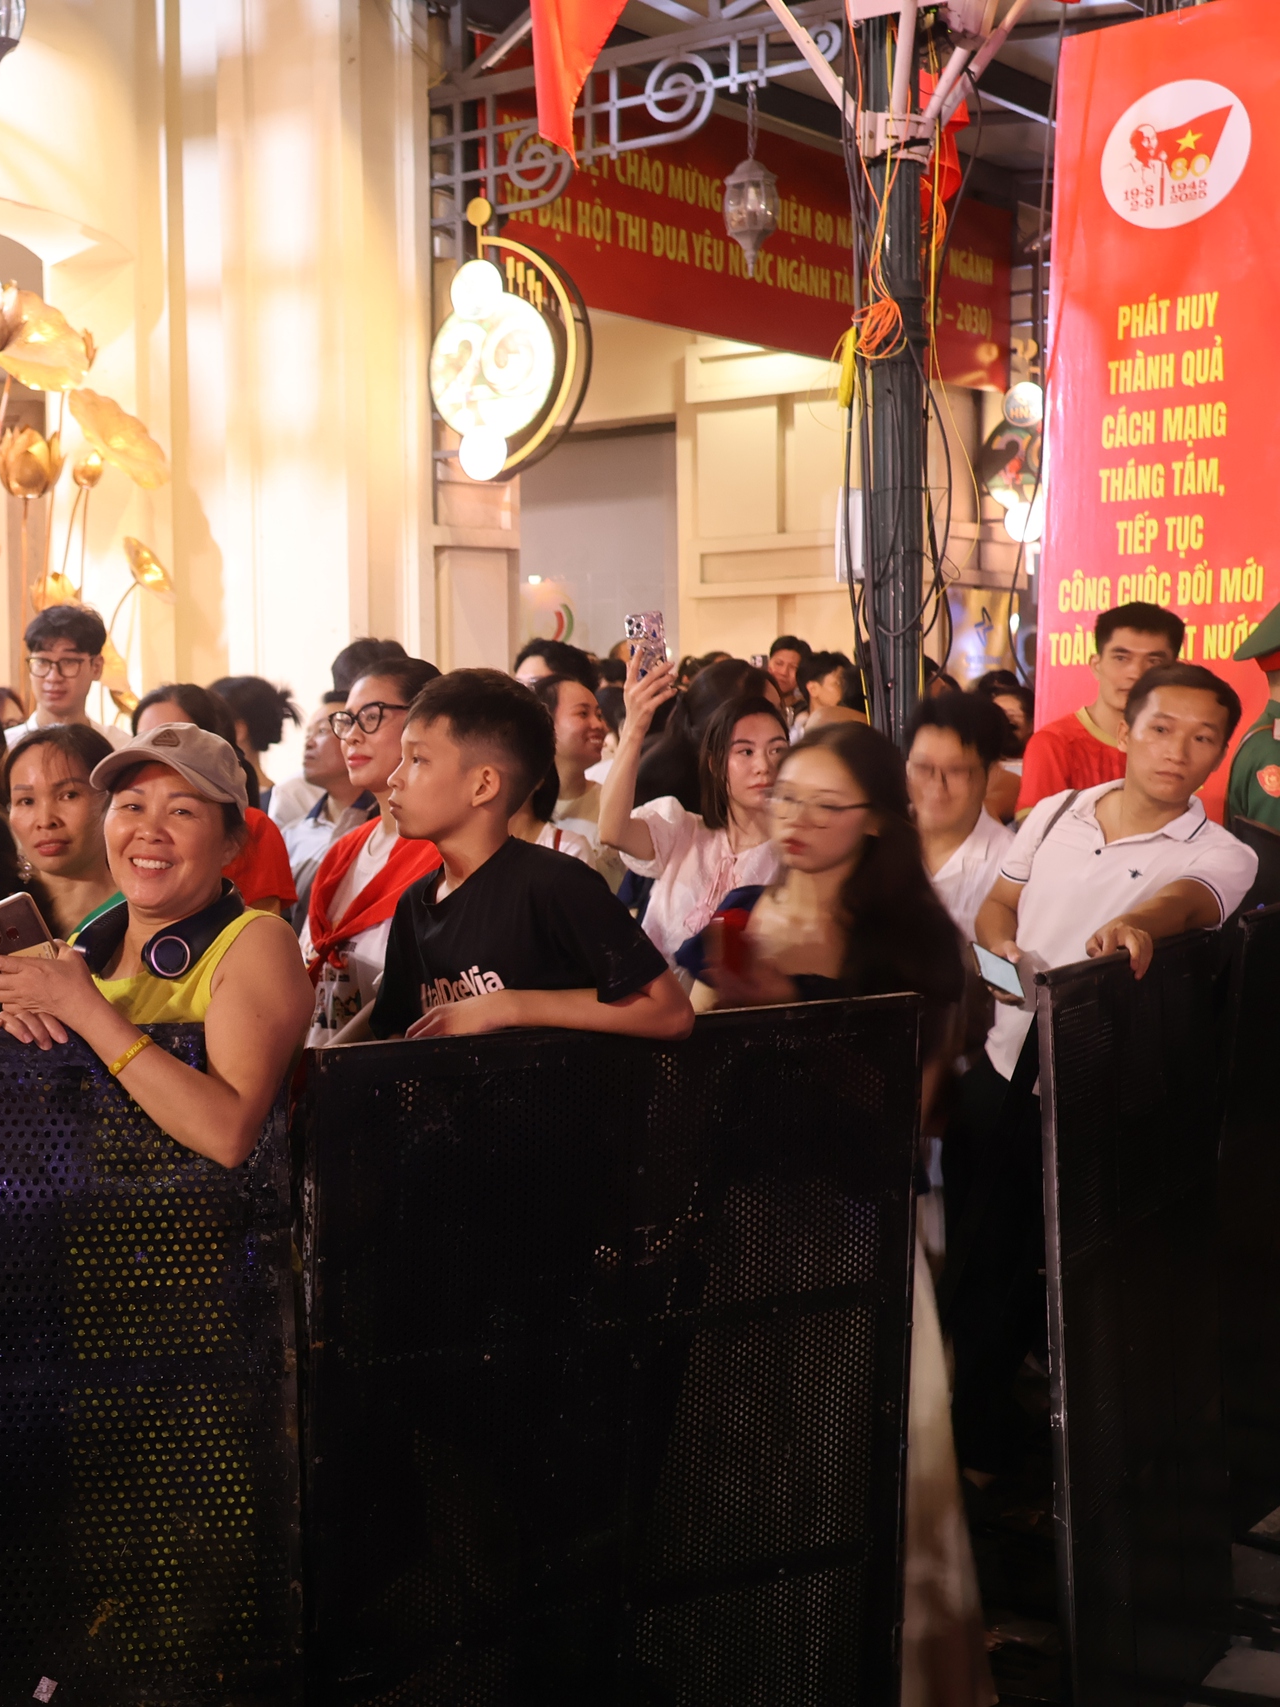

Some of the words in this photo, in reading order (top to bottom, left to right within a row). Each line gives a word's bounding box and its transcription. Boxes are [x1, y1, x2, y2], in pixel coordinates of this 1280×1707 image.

[1170, 153, 1211, 181] 80
[1170, 178, 1208, 194] 1945
[615, 148, 664, 196] CHÀO
[668, 162, 722, 213] MỪNG
[814, 210, 834, 245] 80
[1169, 190, 1208, 205] 2025
[576, 197, 613, 253] HỘI
[616, 210, 648, 254] THI
[651, 221, 690, 265] ĐUA
[692, 228, 725, 274] YÊU
[776, 255, 831, 300] NGÀNH
[1116, 292, 1171, 341] PHÁT
[1175, 290, 1219, 332] HUY
[1107, 349, 1175, 395] THÀNH
[1180, 334, 1225, 388] QUẢ
[1100, 404, 1156, 450] CÁCH
[1161, 400, 1228, 449] MẠNG
[1098, 457, 1166, 503] THÁNG
[1171, 451, 1226, 498] TÁM,
[1115, 510, 1160, 556] TIẾP
[1164, 513, 1205, 559] TỤC
[1057, 568, 1112, 614] CÔNG
[1176, 558, 1214, 607] ĐỔI
[1218, 556, 1265, 604] MỚI
[1202, 613, 1260, 661] NƯỚ
